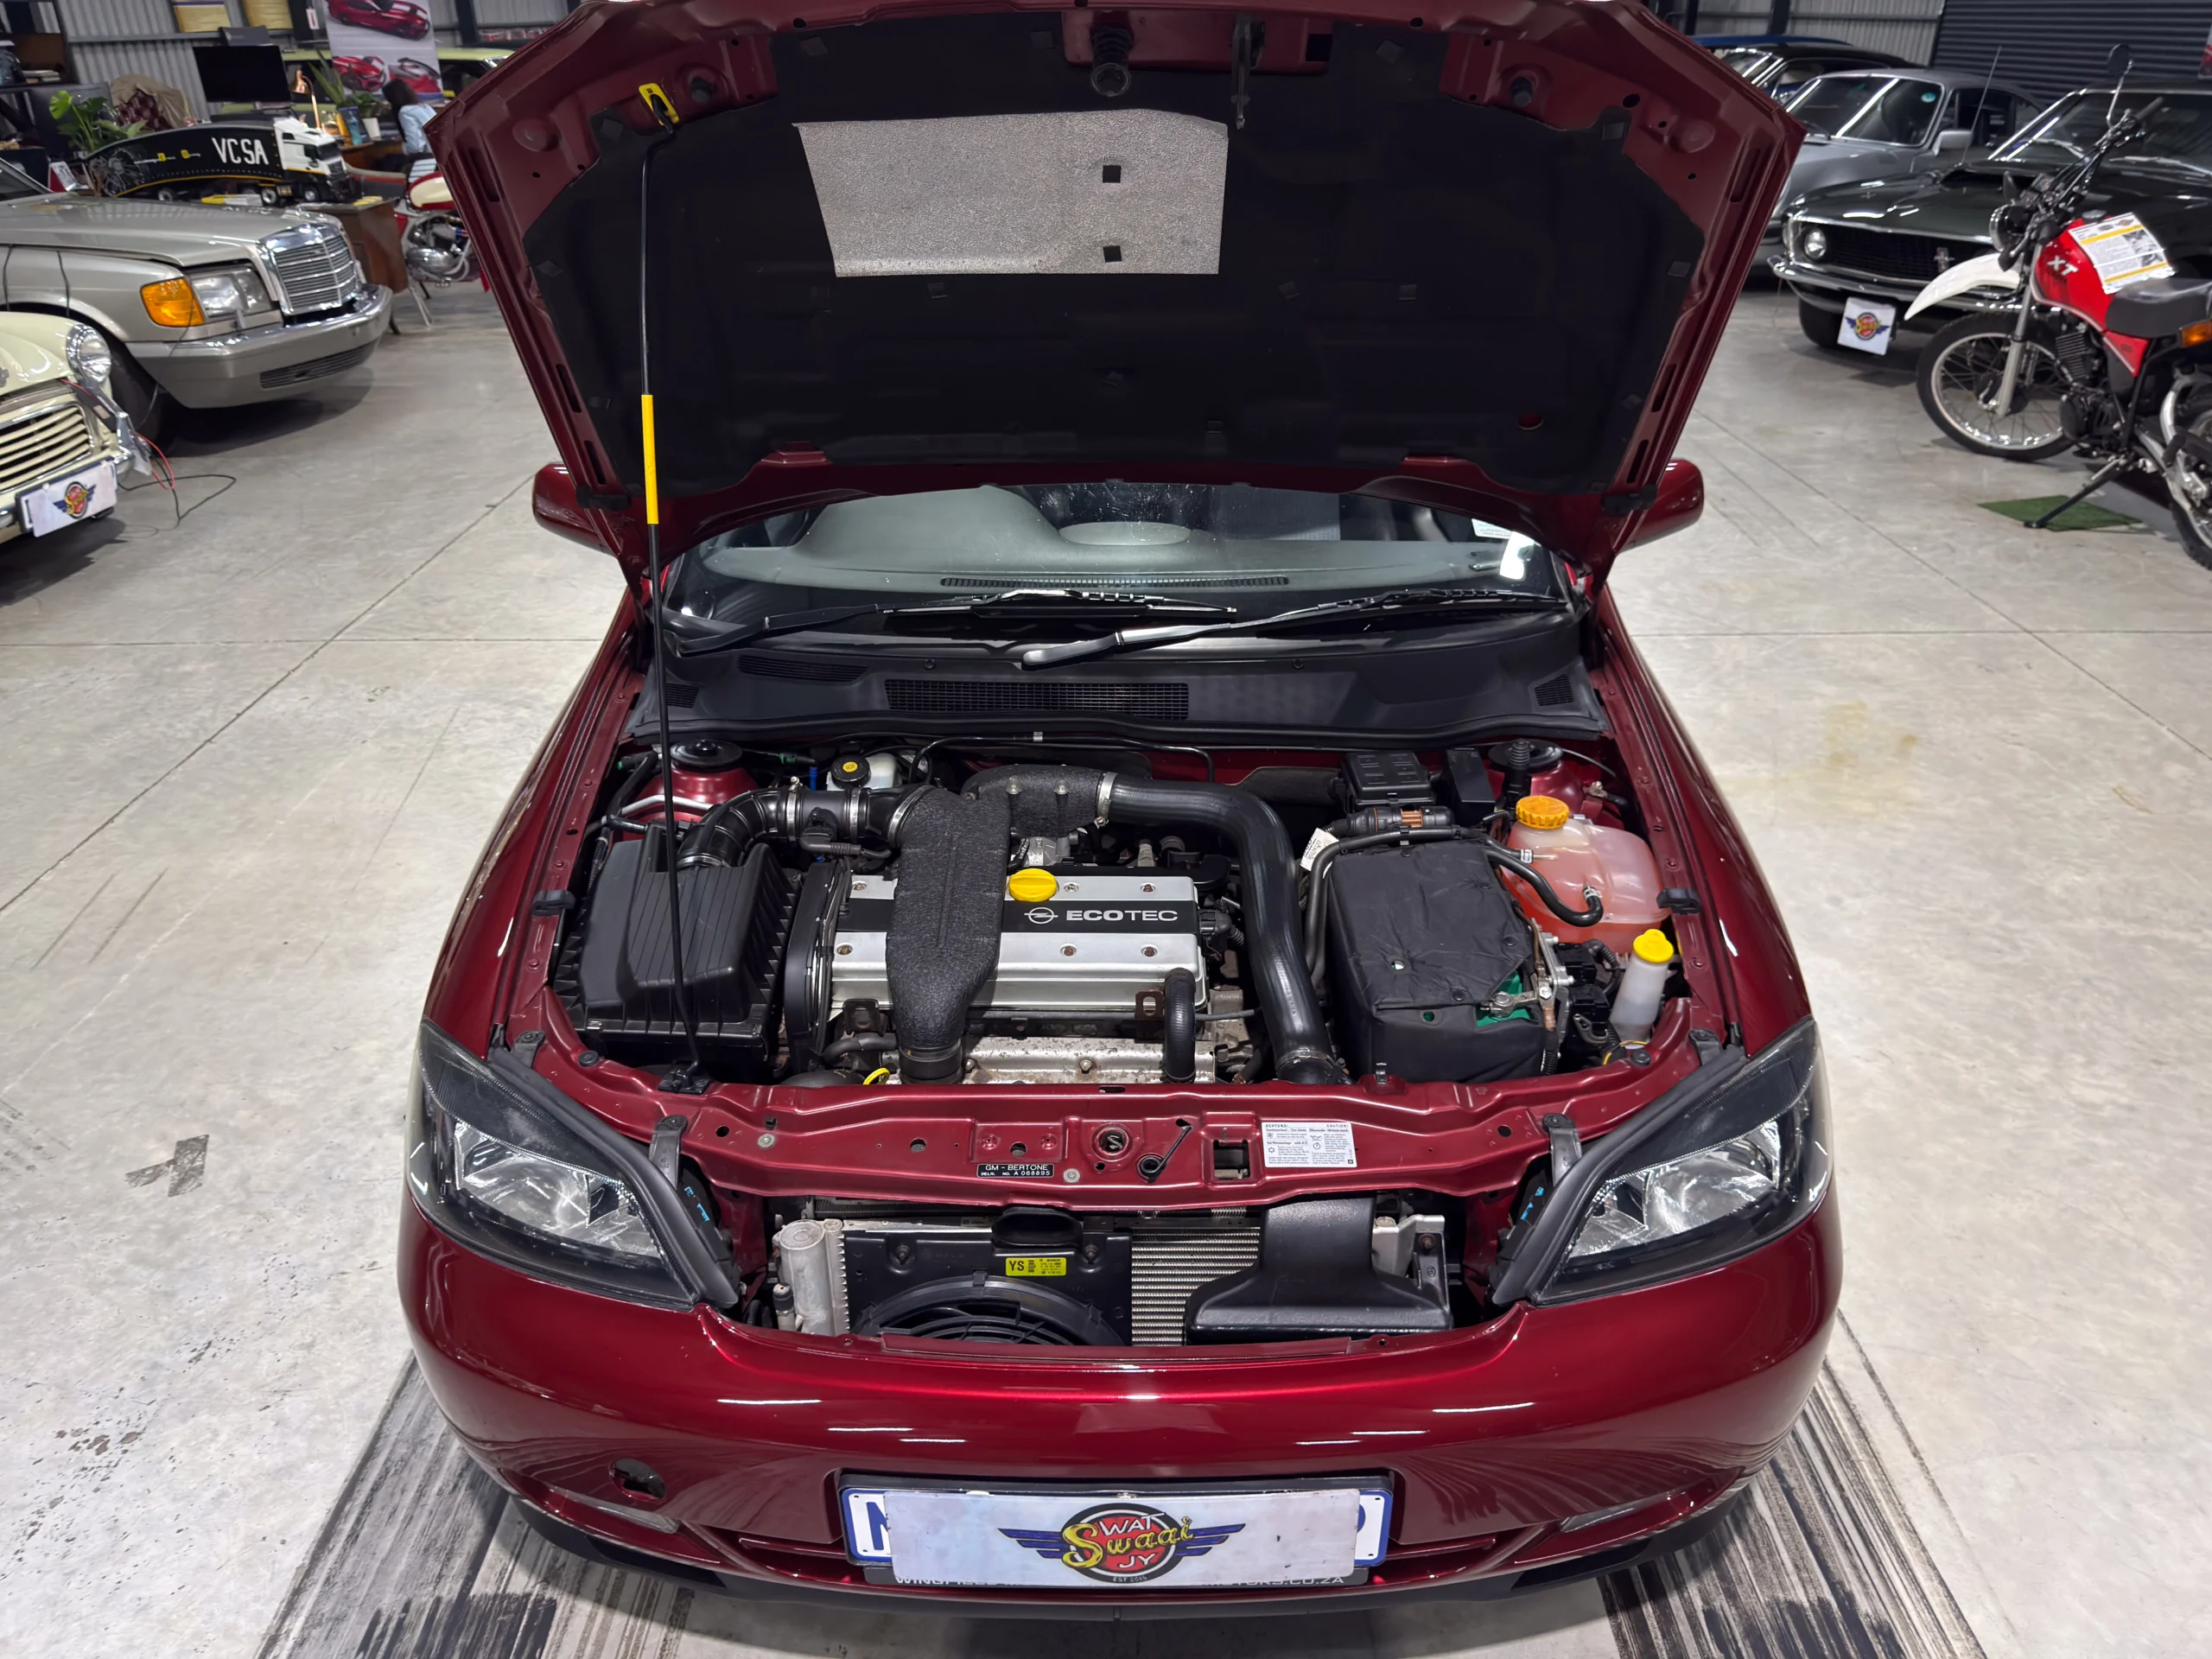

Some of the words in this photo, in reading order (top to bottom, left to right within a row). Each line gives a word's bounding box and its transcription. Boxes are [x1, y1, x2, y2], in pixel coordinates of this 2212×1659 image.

[212, 137, 269, 166] VCSA
[2047, 255, 2079, 276] XT
[1065, 910, 1179, 921] ECOTEC
[1009, 1261, 1025, 1271] YS
[1099, 1512, 1166, 1536] WAT
[1062, 1516, 1193, 1568] Swaai
[1119, 1553, 1156, 1568] JY
